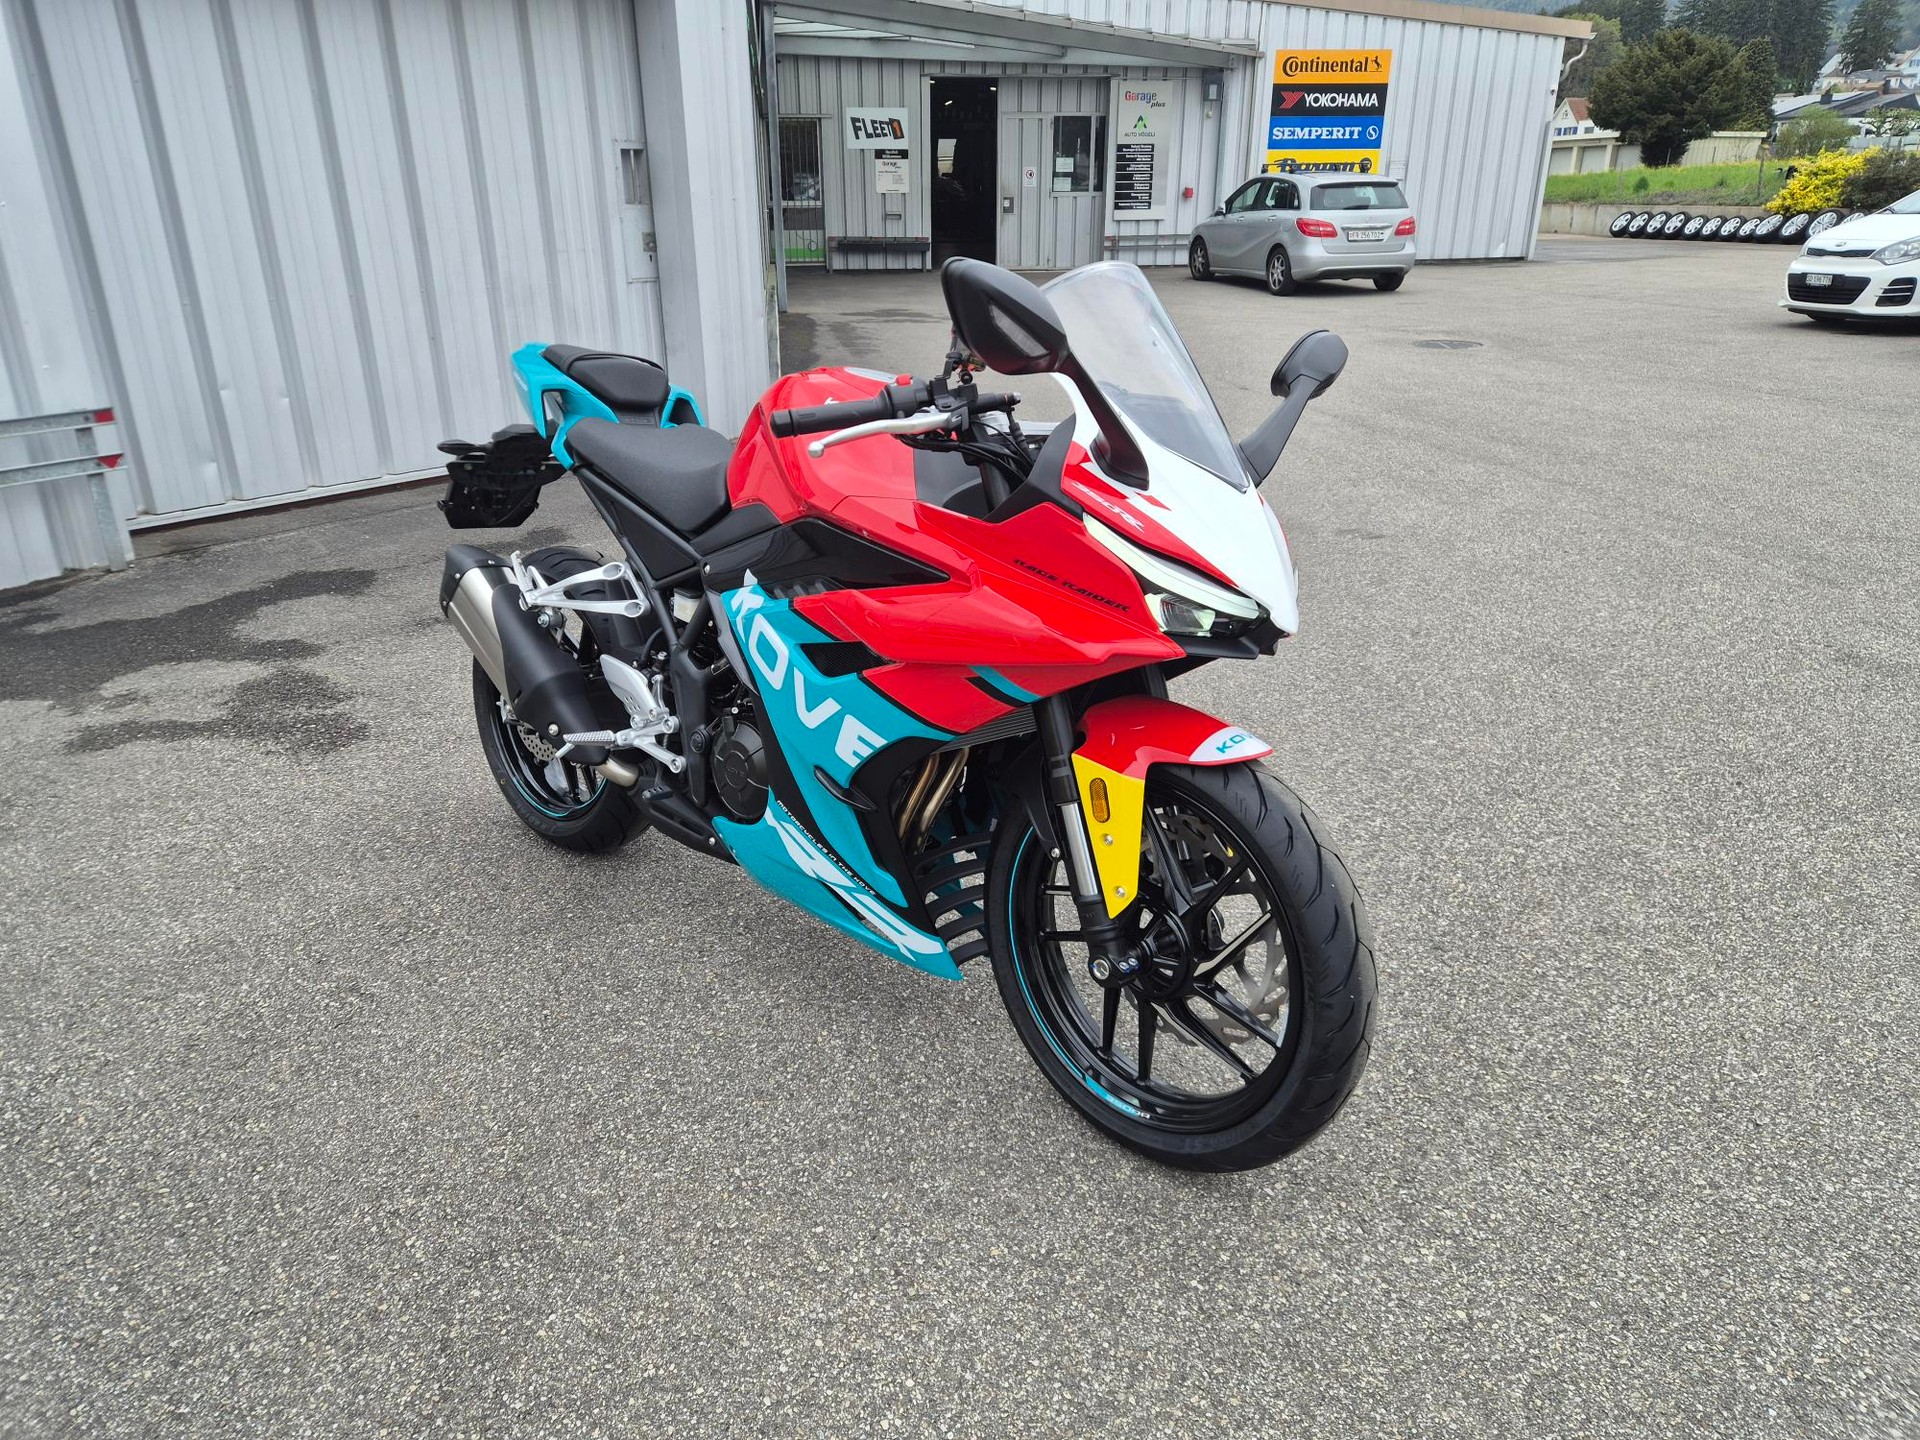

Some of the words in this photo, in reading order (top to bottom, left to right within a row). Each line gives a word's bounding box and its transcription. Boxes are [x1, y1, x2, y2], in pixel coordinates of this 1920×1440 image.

[1282, 56, 1369, 77] Continental
[1125, 90, 1157, 104] Garage
[1304, 92, 1379, 107] YOKOHAMA
[1272, 126, 1362, 140] SEMPERIT
[731, 568, 888, 768] KOVE
[777, 800, 828, 854] MOTORCYCLES
[838, 861, 853, 876] THE
